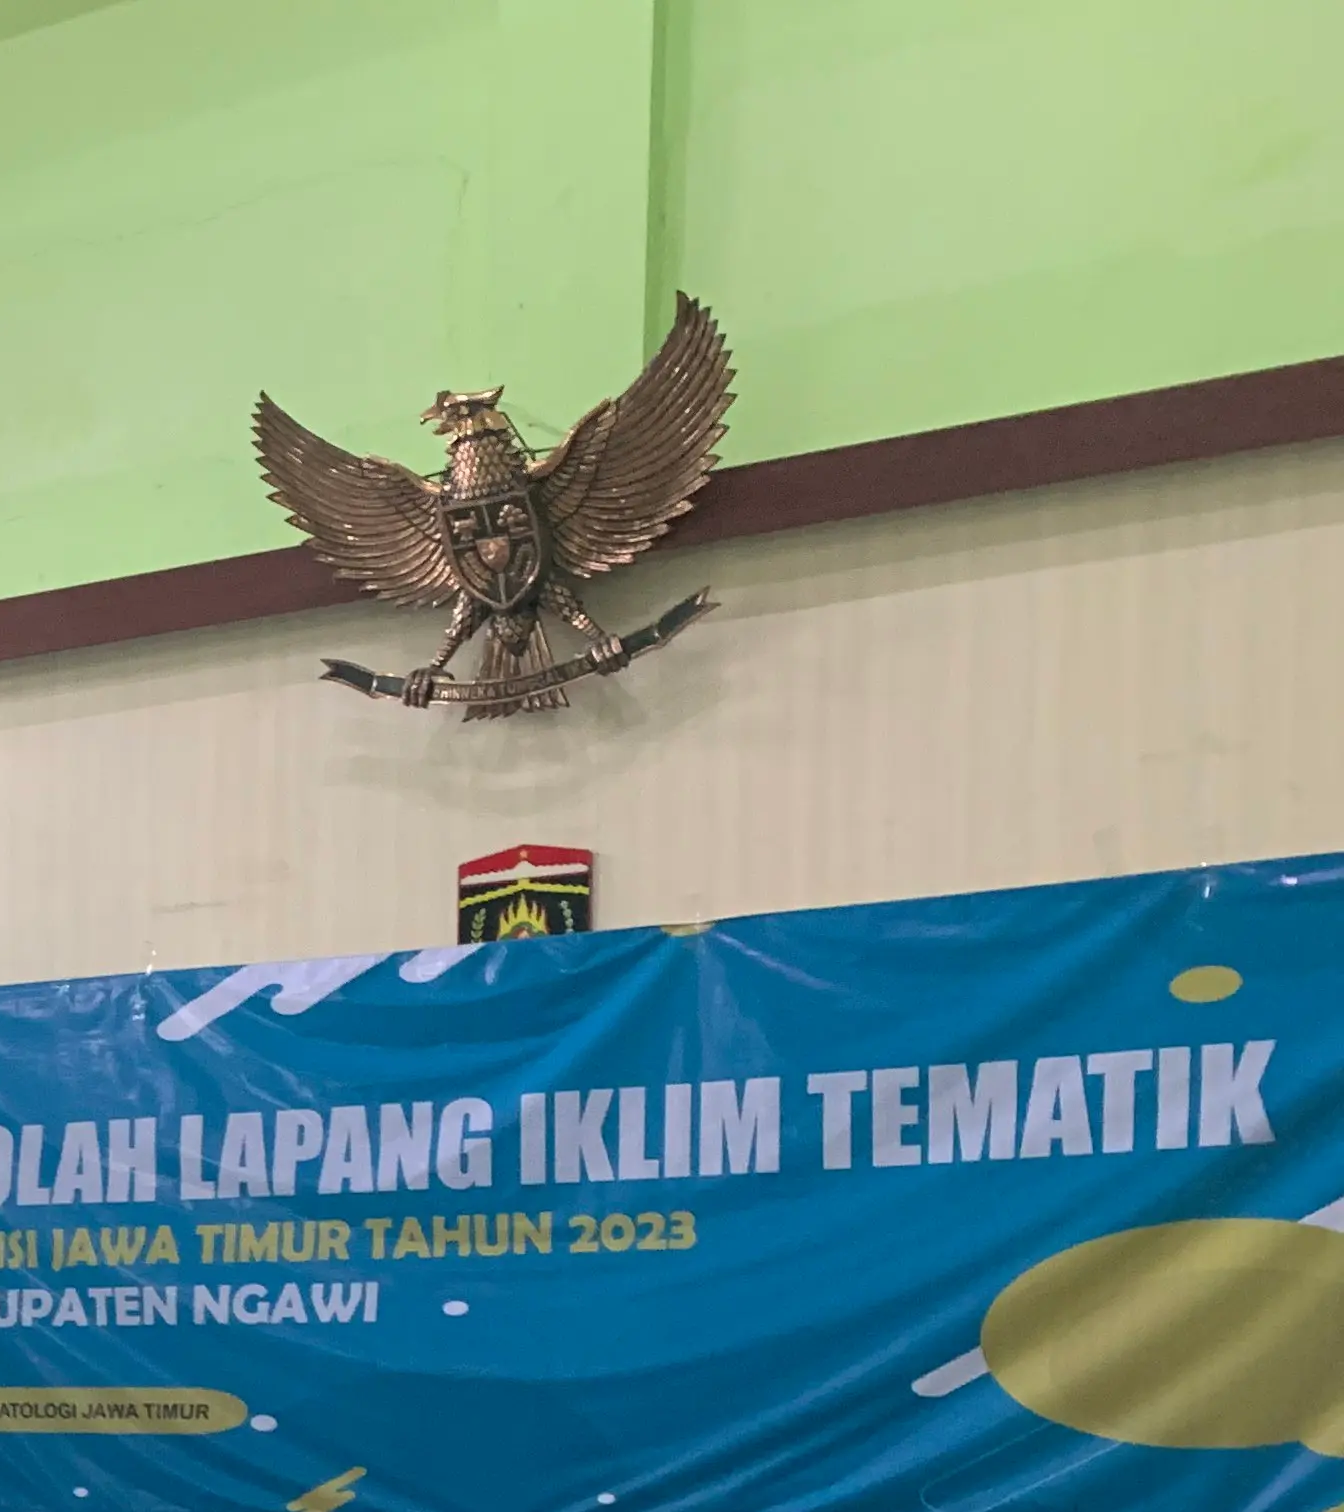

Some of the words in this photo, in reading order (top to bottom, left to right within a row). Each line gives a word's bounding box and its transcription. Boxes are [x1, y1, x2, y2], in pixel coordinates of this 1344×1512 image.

[179, 1096, 493, 1200] LAPANG
[520, 1076, 781, 1185] IKLIM
[807, 1039, 1277, 1170] TEMATIK
[51, 1224, 180, 1272] JAWA
[195, 1219, 351, 1265] TIMUR
[365, 1211, 553, 1260] TAHUN
[568, 1211, 697, 1254] 2023
[193, 1281, 380, 1327] NGAWI
[81, 1402, 139, 1419] JAWA
[143, 1403, 209, 1420] TIMUR
